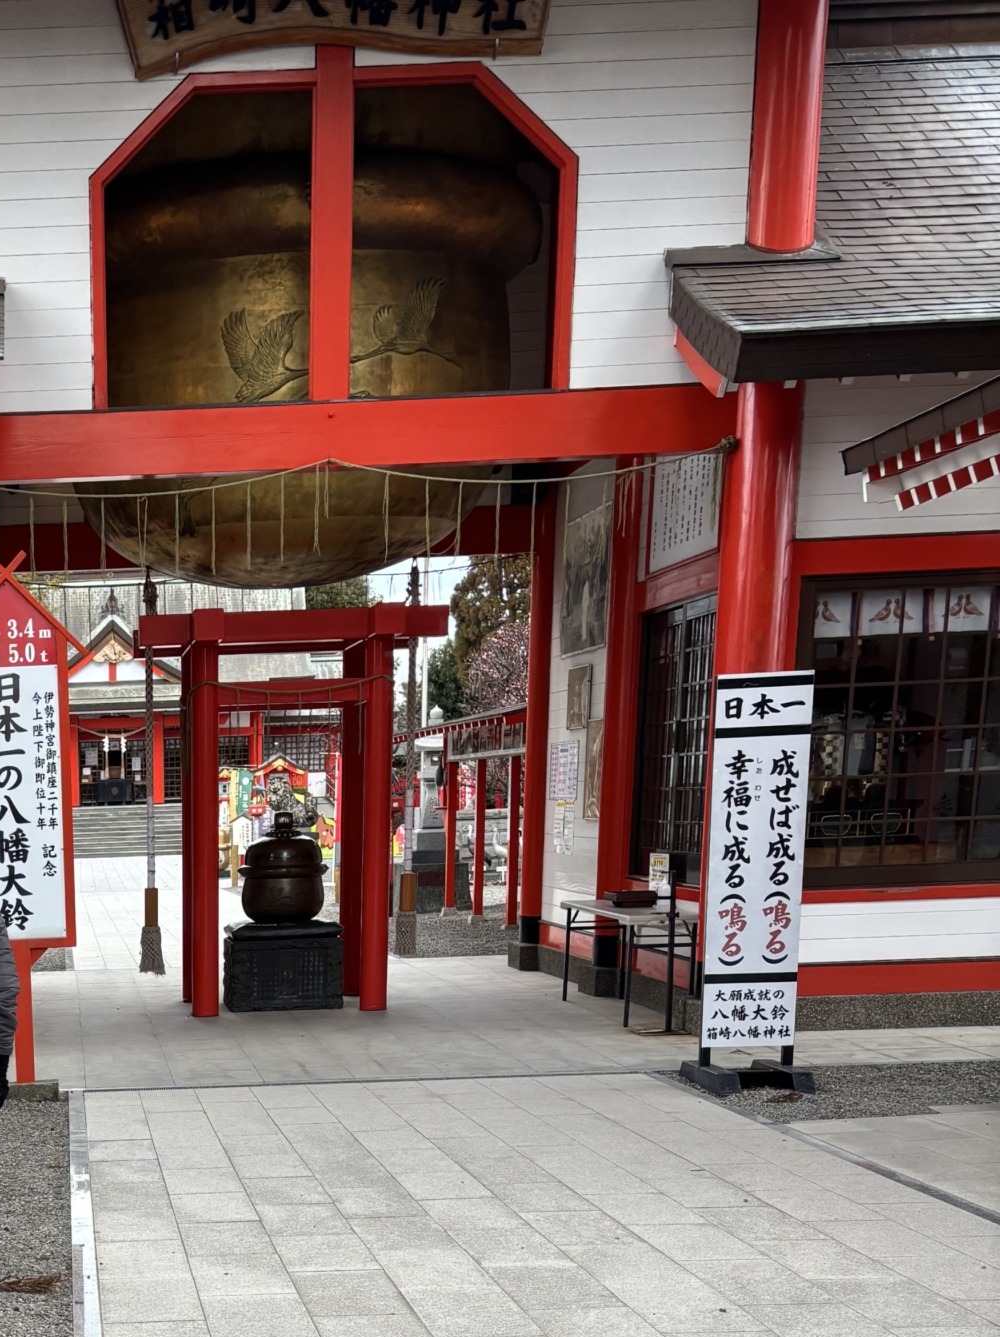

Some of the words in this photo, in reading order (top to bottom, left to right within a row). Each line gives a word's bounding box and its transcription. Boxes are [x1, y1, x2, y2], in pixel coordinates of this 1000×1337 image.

[724, 693, 807, 720] 日本一
[32, 691, 48, 831] 今上陛下御即位十年
[44, 691, 59, 831] 伊勢神宮御鎮座二千年
[41, 843, 58, 878] 記念
[713, 988, 786, 1003] 大願成就の
[710, 1003, 790, 1022] 八幡大鈴
[706, 1024, 791, 1041] 箱崎八幡神社
